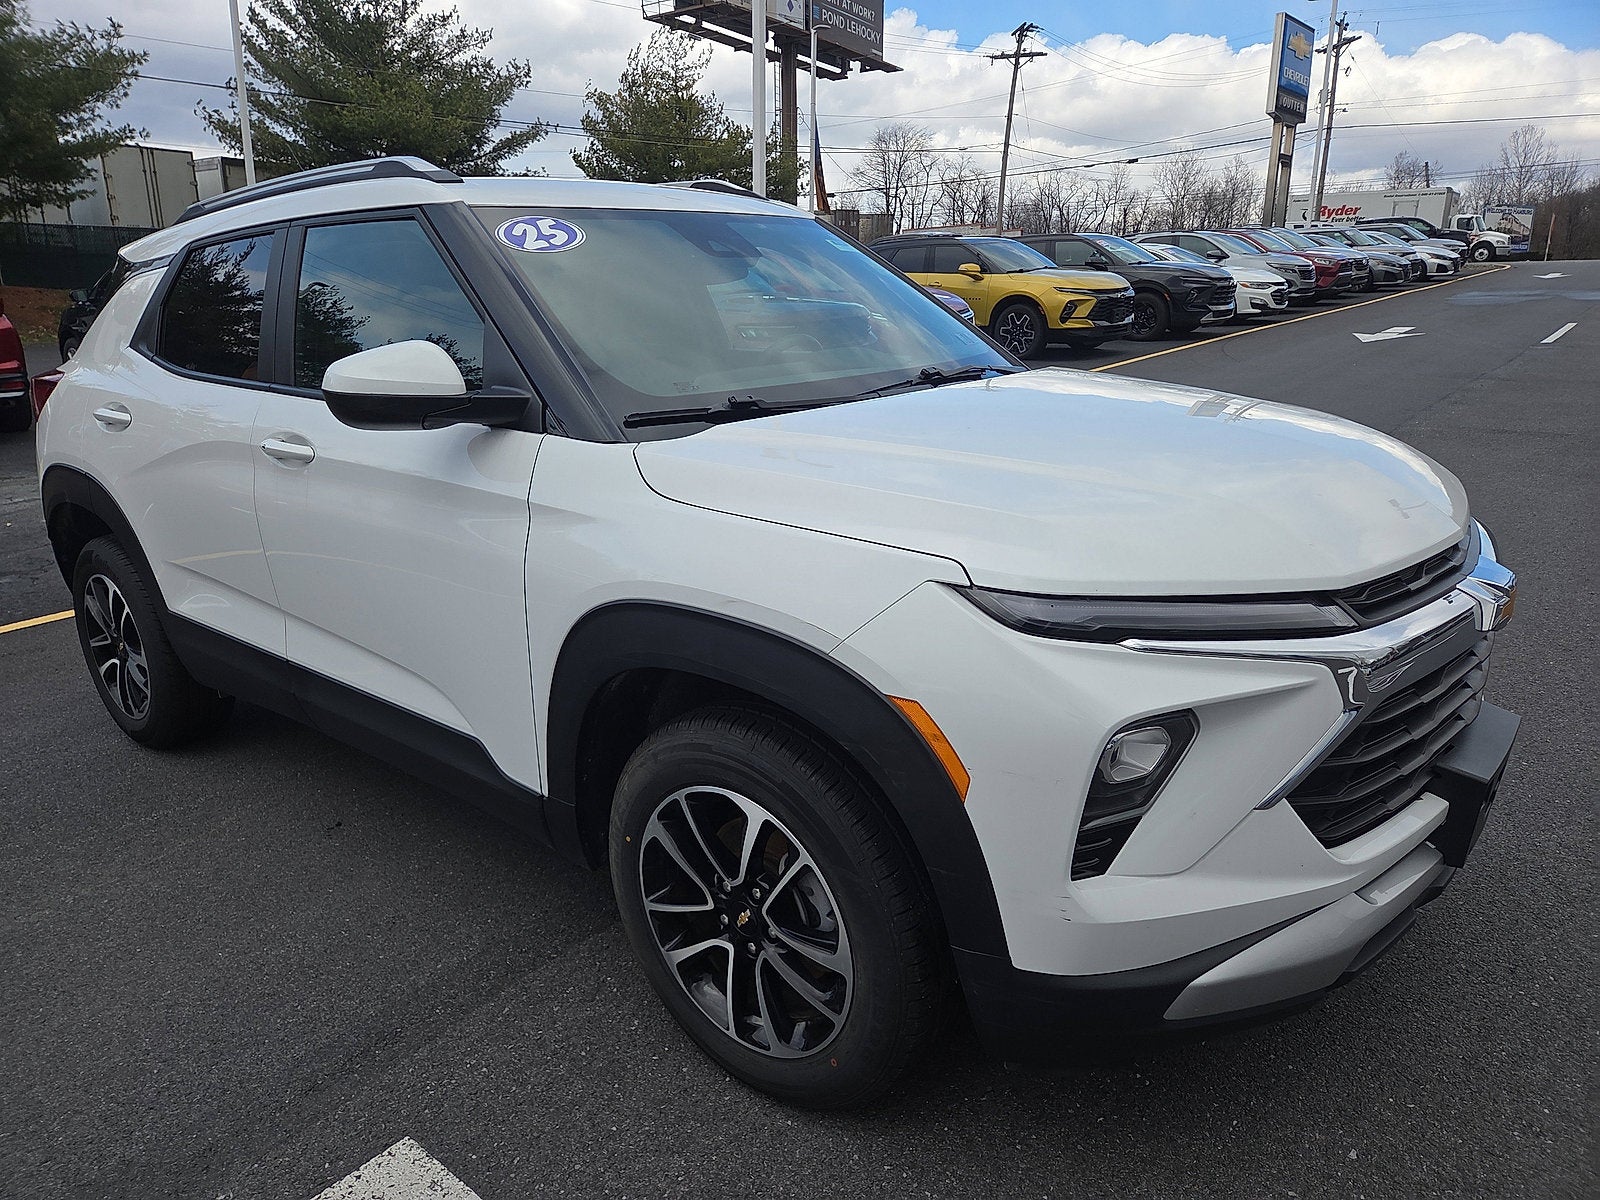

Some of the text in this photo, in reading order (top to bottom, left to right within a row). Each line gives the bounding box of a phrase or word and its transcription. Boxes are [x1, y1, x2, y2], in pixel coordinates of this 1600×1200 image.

[842, 0, 852, 10] AT
[852, 2, 875, 21] WORK?
[822, 9, 845, 29] POND
[846, 19, 881, 44] LEHOCKY
[1319, 204, 1362, 219] Ryder
[511, 218, 569, 250] 25
